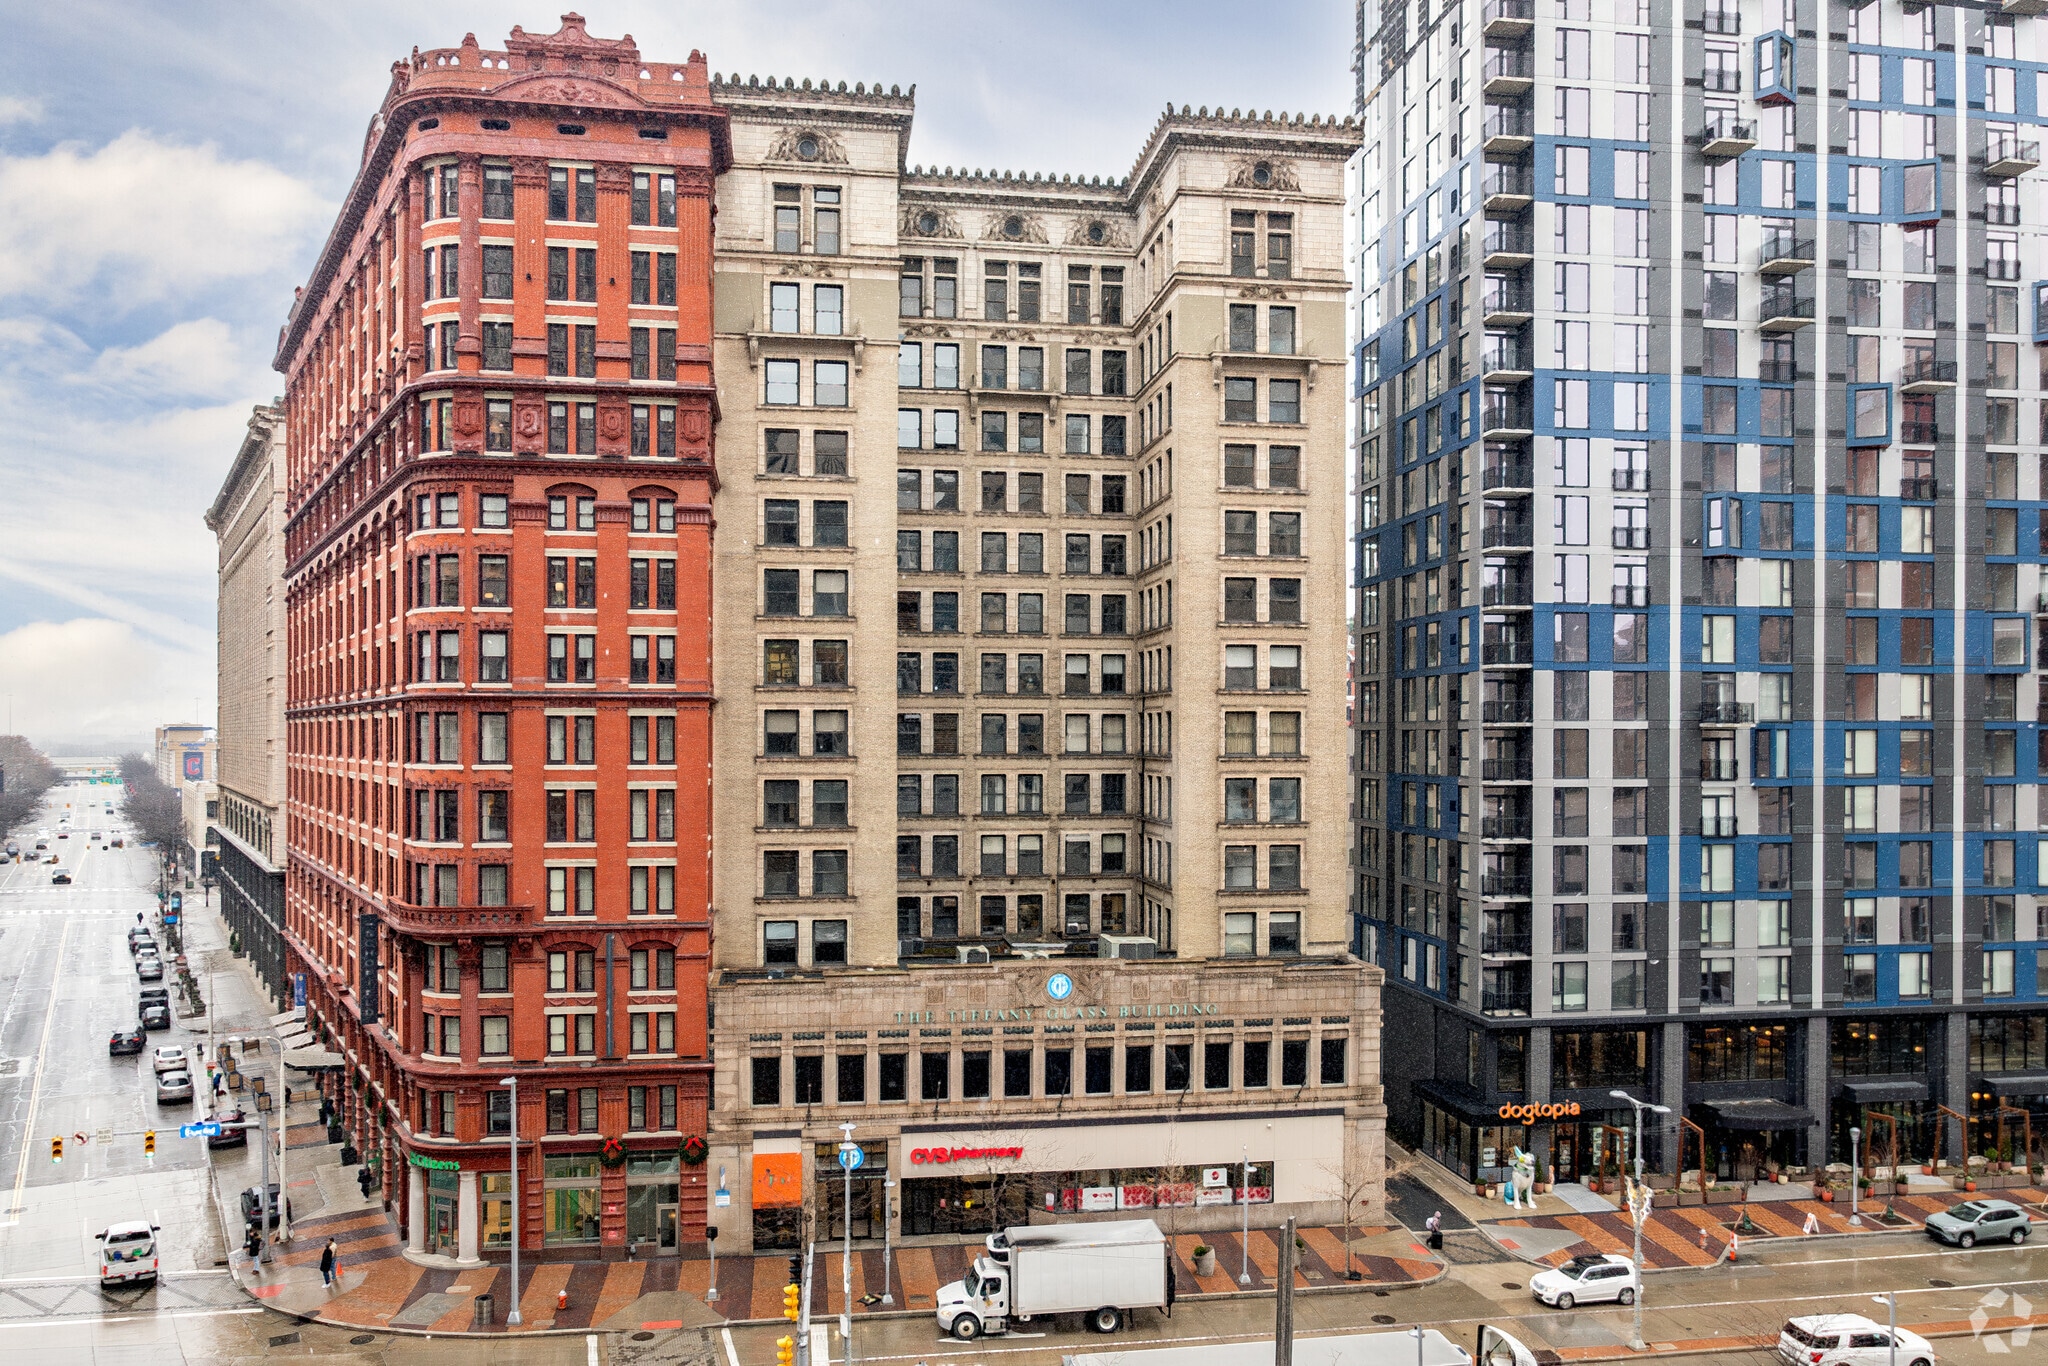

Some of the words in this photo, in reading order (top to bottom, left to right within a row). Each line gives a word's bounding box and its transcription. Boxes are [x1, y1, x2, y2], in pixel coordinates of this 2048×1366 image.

[187, 757, 200, 775] C
[895, 1011, 934, 1024] THE
[948, 1009, 1035, 1023] TIFFANY
[1046, 1006, 1107, 1020] GLASS
[1119, 1003, 1218, 1018] BUILDING
[1498, 1099, 1581, 1126] dogtopia
